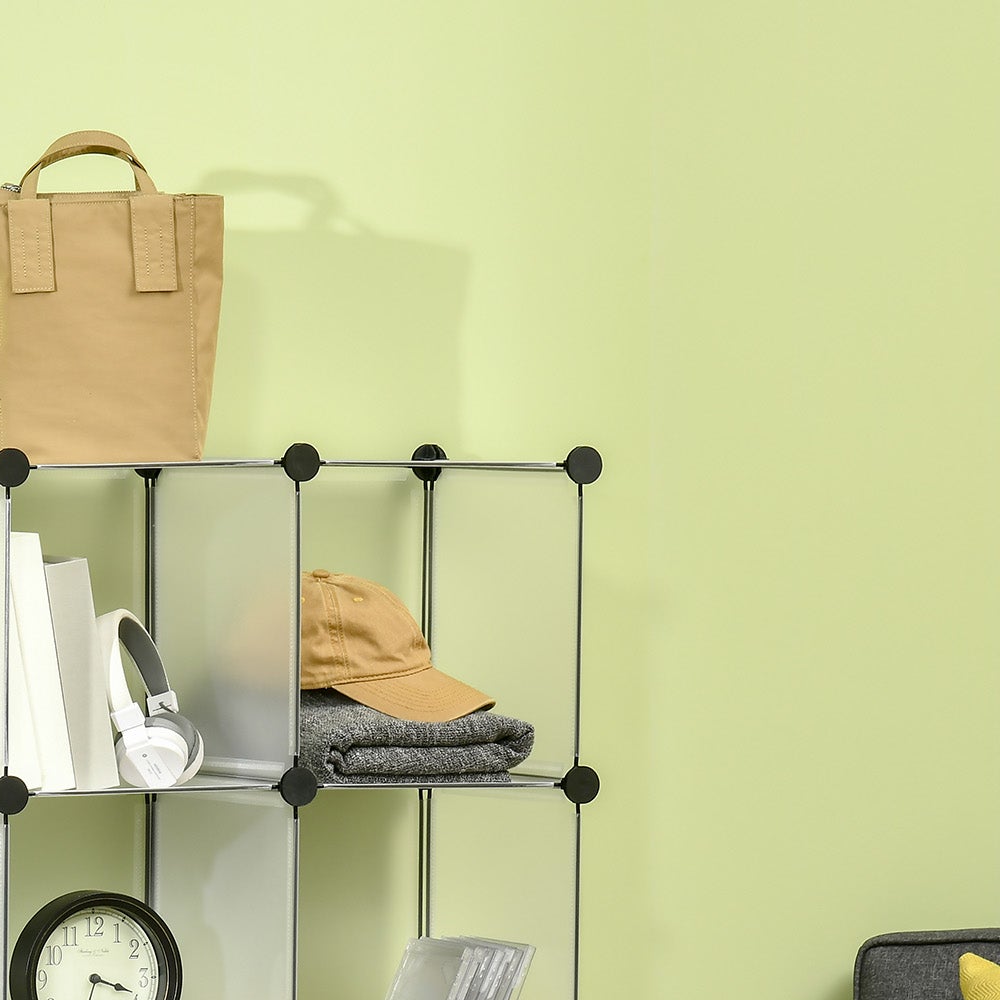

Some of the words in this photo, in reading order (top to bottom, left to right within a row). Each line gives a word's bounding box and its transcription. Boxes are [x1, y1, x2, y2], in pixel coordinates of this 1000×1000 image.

[62, 926, 78, 946] 11
[84, 916, 104, 937] 12
[112, 923, 121, 943] 1
[45, 945, 63, 966] 10
[129, 939, 139, 959] 2
[38, 969, 47, 990] 9
[138, 968, 149, 988] 3
